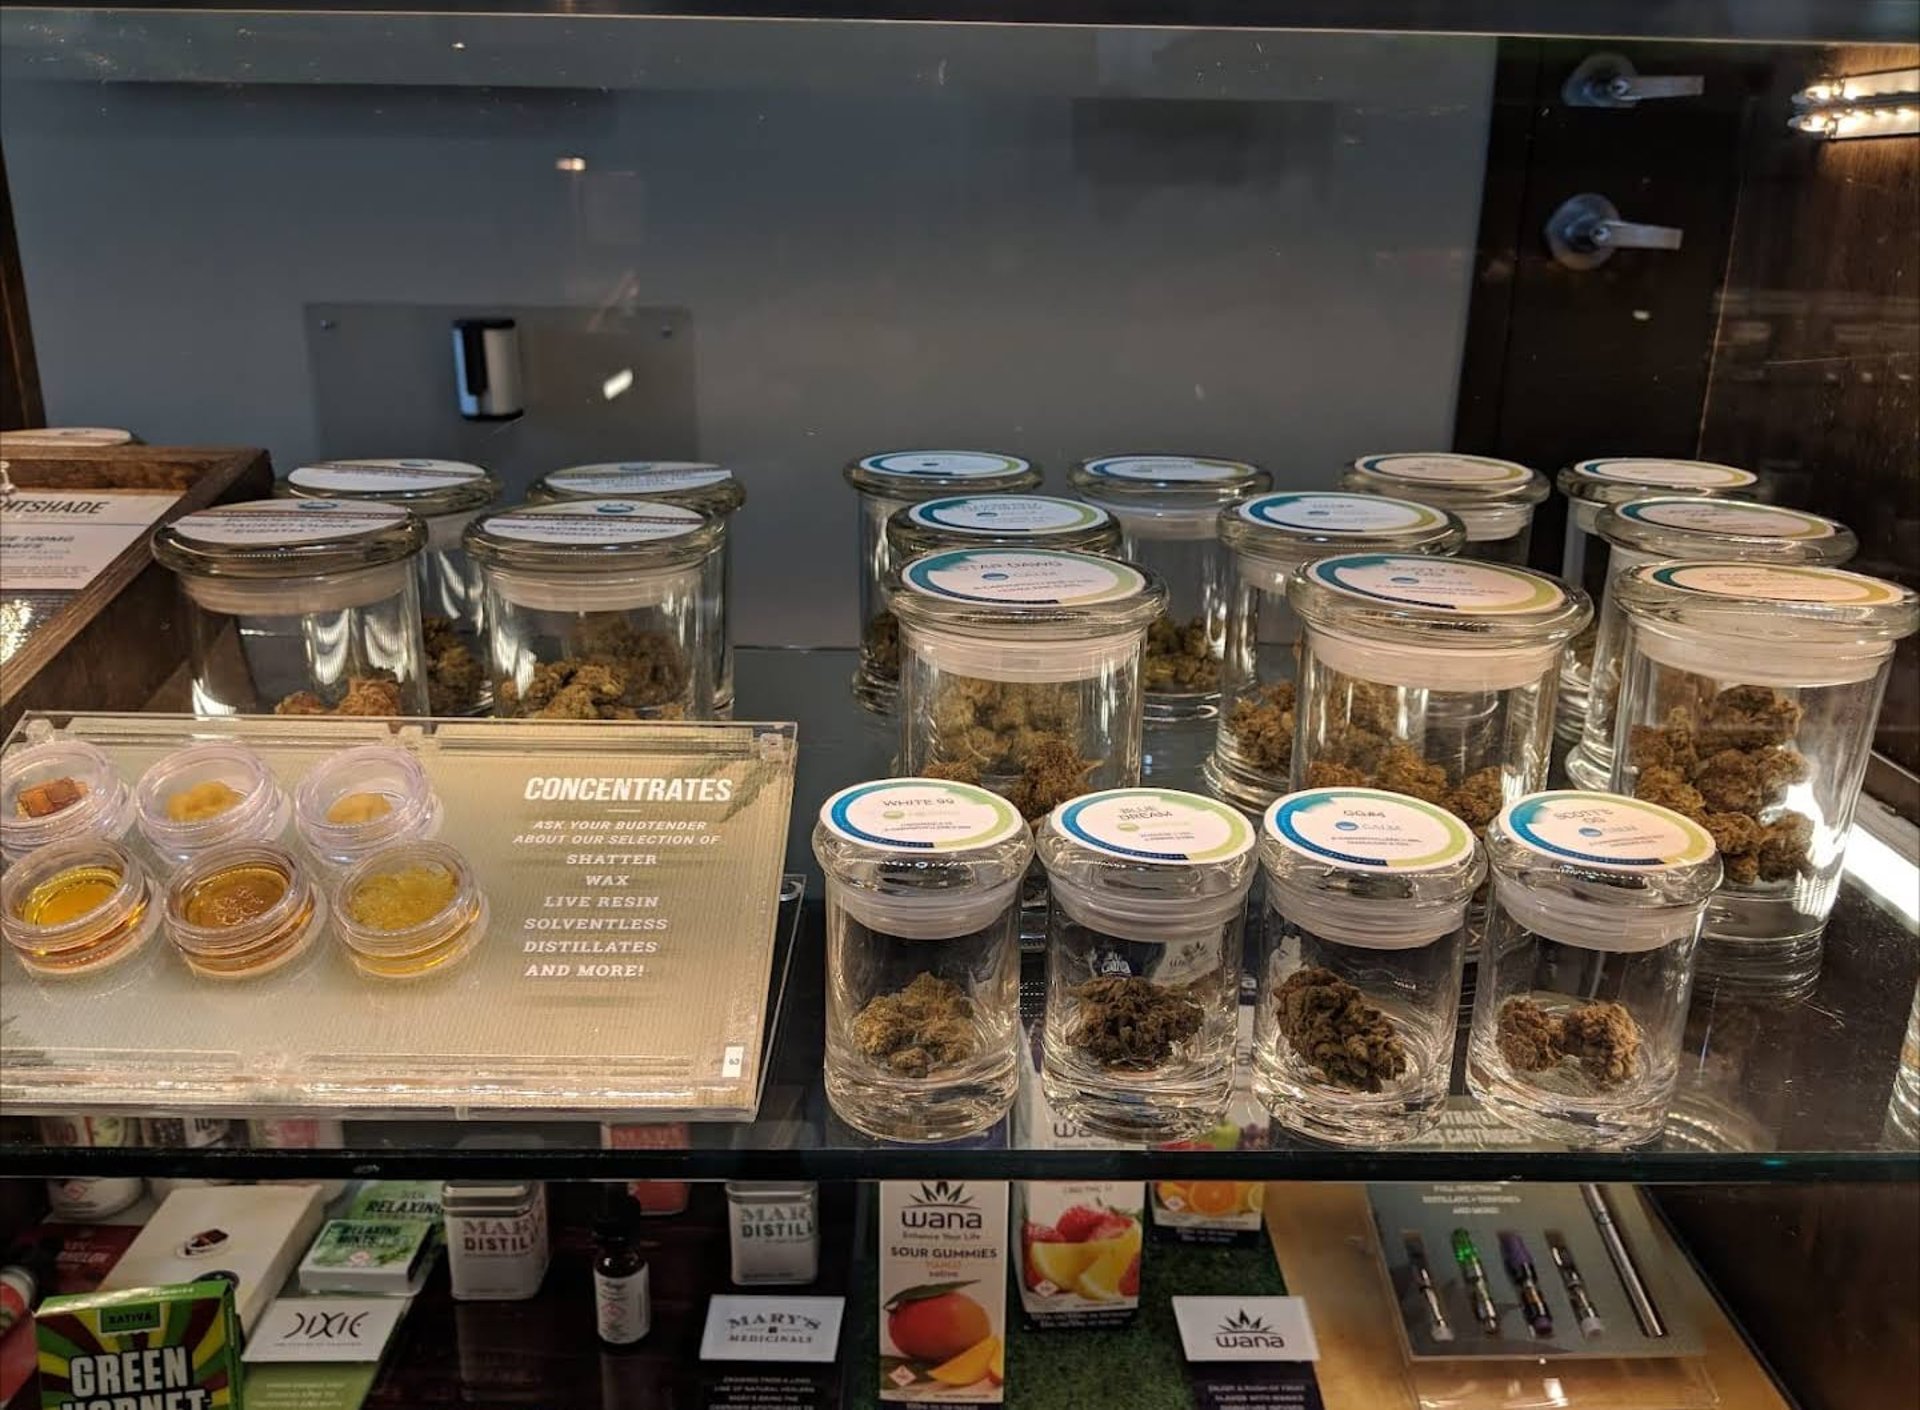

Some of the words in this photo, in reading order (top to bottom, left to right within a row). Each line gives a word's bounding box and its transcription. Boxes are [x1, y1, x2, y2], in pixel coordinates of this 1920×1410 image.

[523, 776, 733, 802] CONCENTRATES
[882, 799, 933, 807] WHITE
[533, 820, 564, 831] ASK
[570, 820, 611, 831] YOUR
[614, 820, 707, 831] BUDTENDER
[512, 834, 566, 845] ABOUT
[571, 834, 605, 845] OUR
[609, 834, 695, 845] SELECTION
[699, 834, 721, 845] OF
[566, 854, 658, 866] SHATTER
[585, 875, 630, 886] WAX
[543, 896, 592, 908] LIVE
[597, 896, 659, 908] RESIN
[523, 918, 669, 931] SOLVENTLESS
[522, 941, 659, 954] DISTILLATES
[525, 965, 570, 977] AND
[576, 964, 645, 978] MORE!
[902, 1211, 983, 1229] wana
[890, 1246, 929, 1258] SOUR
[932, 1248, 998, 1259] GUMMIES
[109, 1311, 152, 1324] SATIVA
[727, 1312, 822, 1331] MARY'S
[284, 1311, 370, 1339] DIXIE
[728, 1335, 814, 1344] MEDICINALS
[1215, 1335, 1285, 1349] wana
[70, 1345, 189, 1398] GREEN
